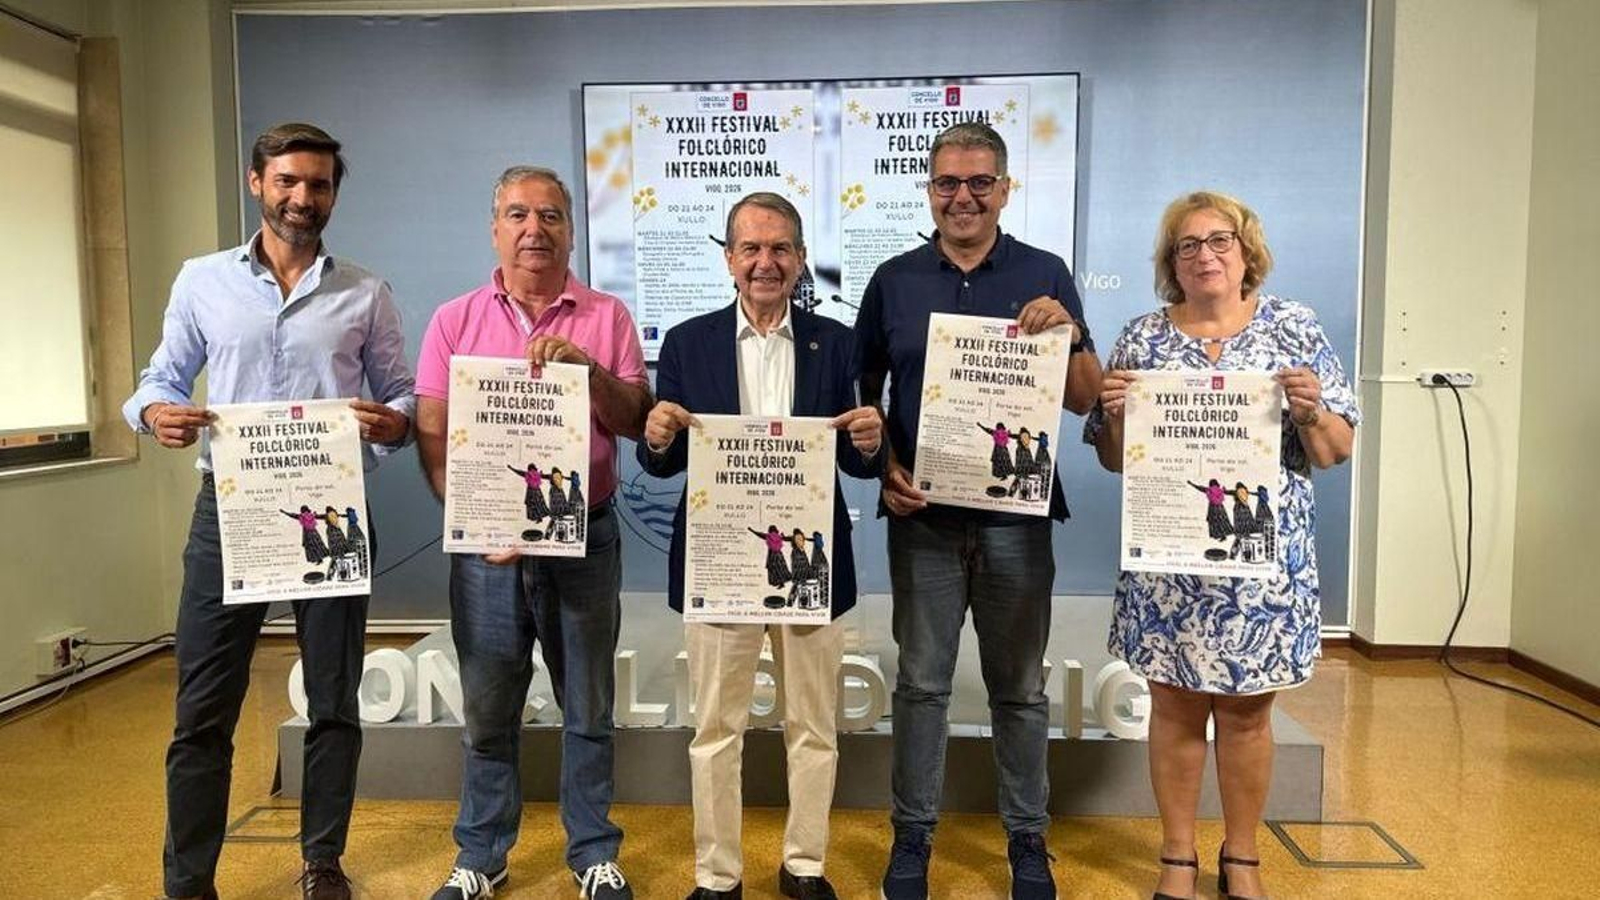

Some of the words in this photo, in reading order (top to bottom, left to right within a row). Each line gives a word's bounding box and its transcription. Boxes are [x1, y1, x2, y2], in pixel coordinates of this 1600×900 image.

[666, 117, 705, 133] XXXII
[712, 115, 779, 133] FESTIVAL
[876, 112, 917, 129] XXXII
[679, 134, 766, 156] FOLCLÓRICO
[665, 160, 781, 178] INTERNACIONAL
[954, 336, 985, 351] XXXII
[988, 340, 1039, 356] FESTIVAL
[961, 353, 1029, 371] FOLCLÓRICO
[950, 367, 1036, 388] INTERNACIONAL
[478, 379, 510, 393] XXXII
[514, 380, 564, 396] FESTIVAL
[487, 394, 555, 411] FOLCLÓRICO
[1155, 393, 1188, 406] XXXII
[1193, 393, 1250, 406] FESTIVAL
[476, 411, 564, 428] INTERNACIONAL
[1165, 406, 1239, 422] FOLCLÓRICO
[239, 424, 271, 438] XXXII
[275, 421, 330, 437] FESTIVAL
[1153, 425, 1250, 440] INTERNACIONAL
[250, 436, 320, 454] FOLCLÓRICO
[717, 438, 749, 451] XXXII
[753, 439, 806, 453] FESTIVAL
[240, 453, 333, 471] INTERNACIONAL
[727, 452, 796, 469] FOLCLÓRICO
[716, 471, 806, 486] INTERNACIONAL
